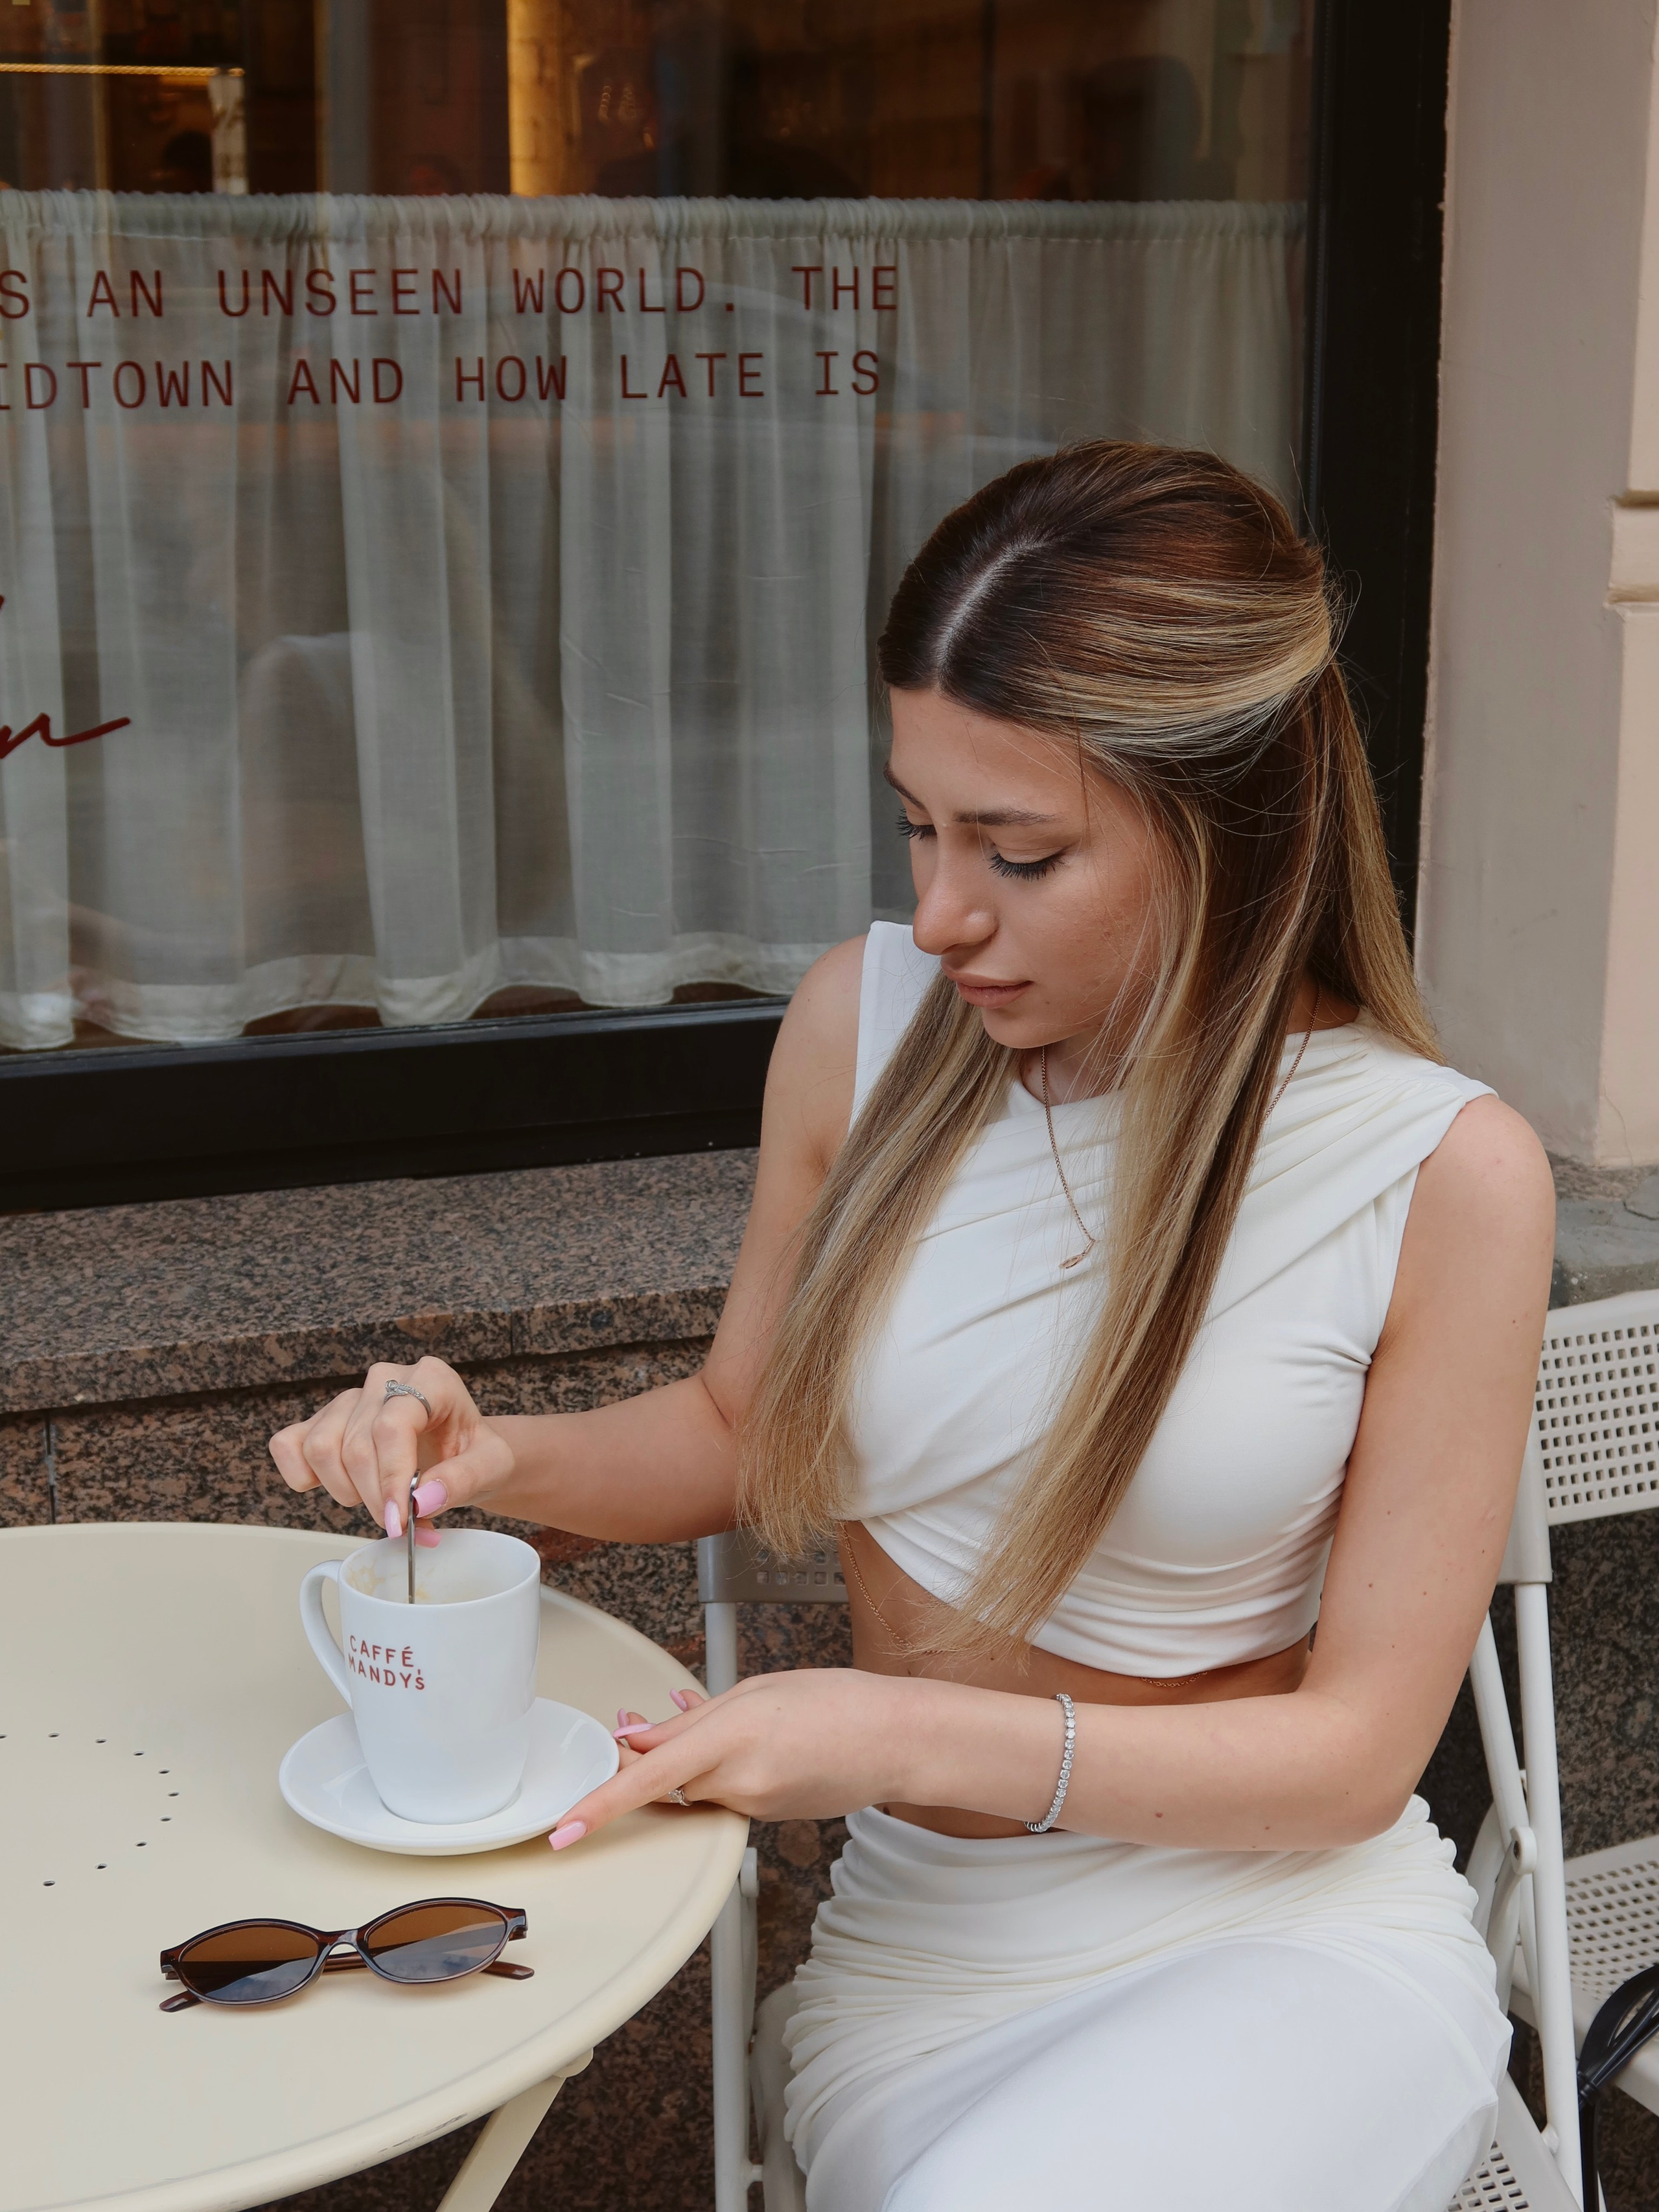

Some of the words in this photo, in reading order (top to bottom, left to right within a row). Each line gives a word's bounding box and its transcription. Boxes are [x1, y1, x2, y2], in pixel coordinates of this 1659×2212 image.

[87, 269, 163, 318] AN
[218, 268, 463, 318] UNSEEN
[512, 266, 734, 314] WORLD.
[791, 265, 898, 310] THE
[287, 357, 403, 405] AND
[455, 355, 567, 402] HOW
[620, 351, 765, 399] LATE
[815, 349, 879, 395] IS
[349, 1635, 414, 1668] CAFFÉ
